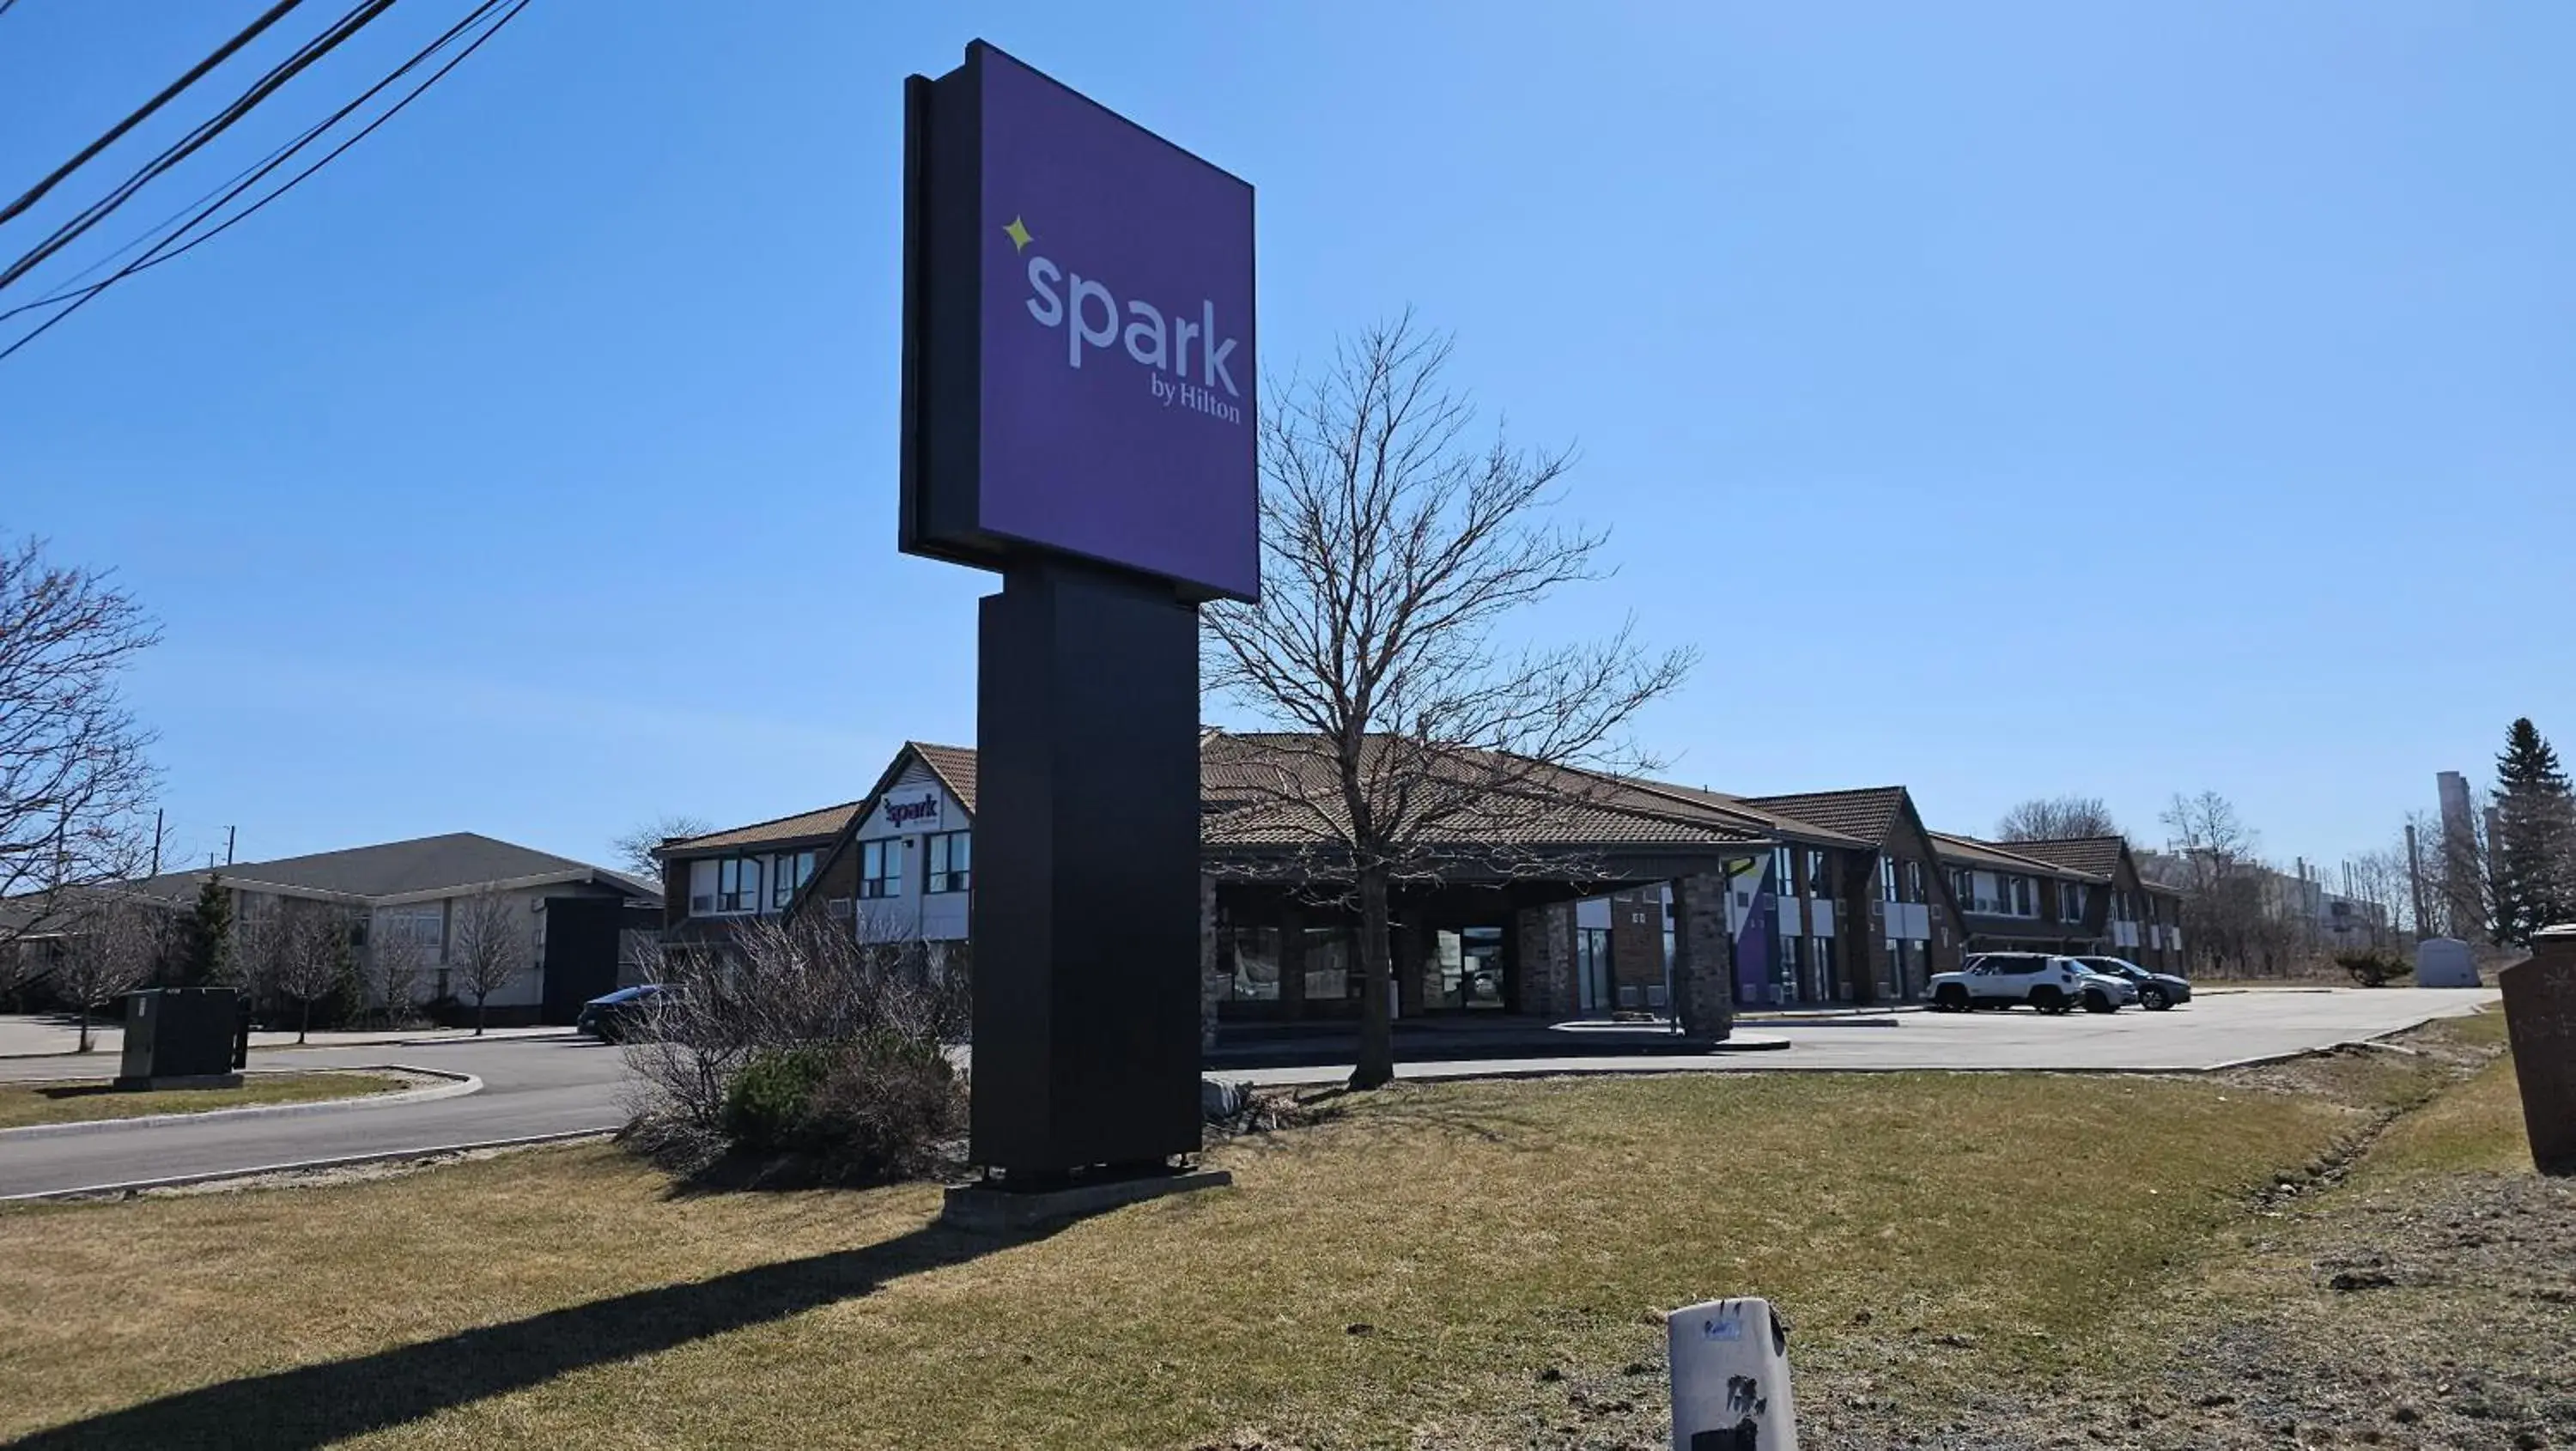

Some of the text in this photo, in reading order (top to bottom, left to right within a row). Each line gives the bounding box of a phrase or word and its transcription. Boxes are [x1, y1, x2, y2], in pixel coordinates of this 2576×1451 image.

[1025, 256, 1239, 397] spark
[1151, 372, 1241, 425] by Hilton
[885, 792, 938, 829] spark
